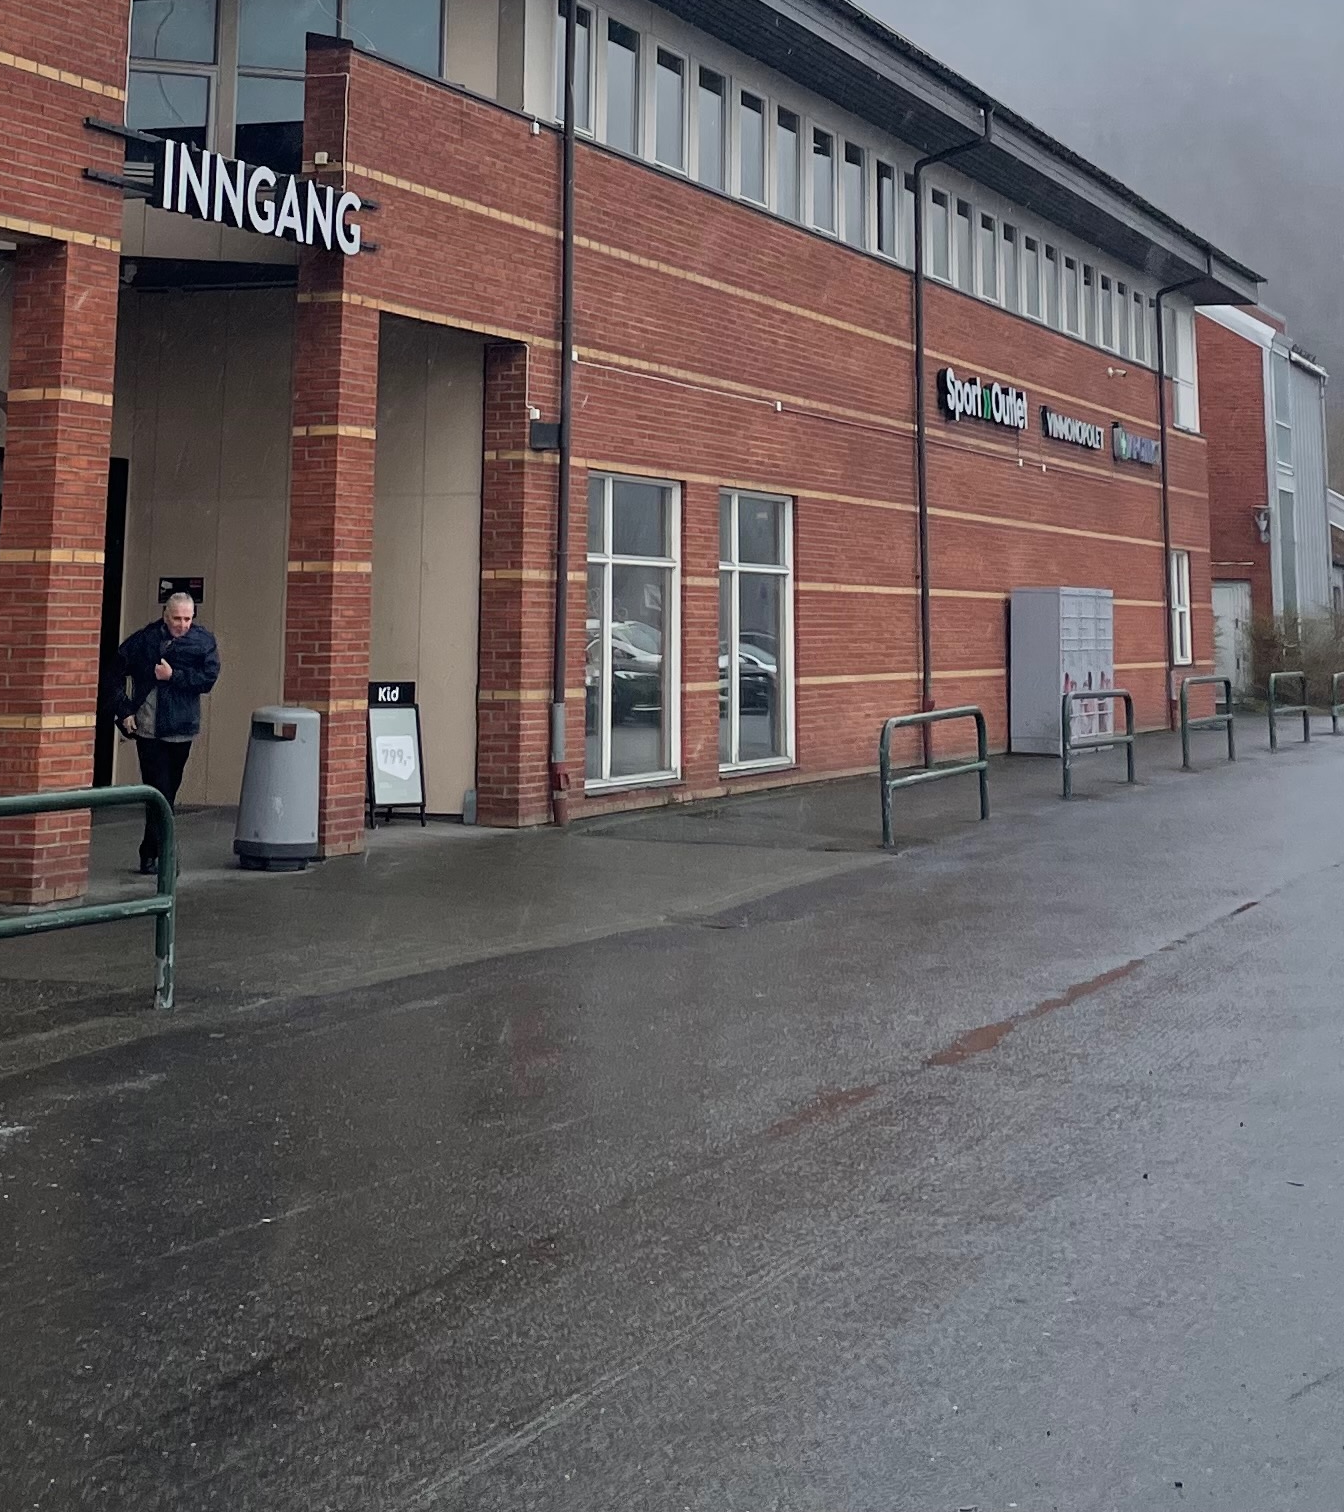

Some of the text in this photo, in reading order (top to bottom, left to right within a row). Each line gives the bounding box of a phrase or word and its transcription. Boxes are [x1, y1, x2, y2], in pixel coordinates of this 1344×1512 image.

[163, 139, 361, 255] INNGANG
[946, 367, 1028, 430] Sport Outlet
[1046, 412, 1104, 450] VINMONOPOLET
[378, 686, 400, 702] Kid
